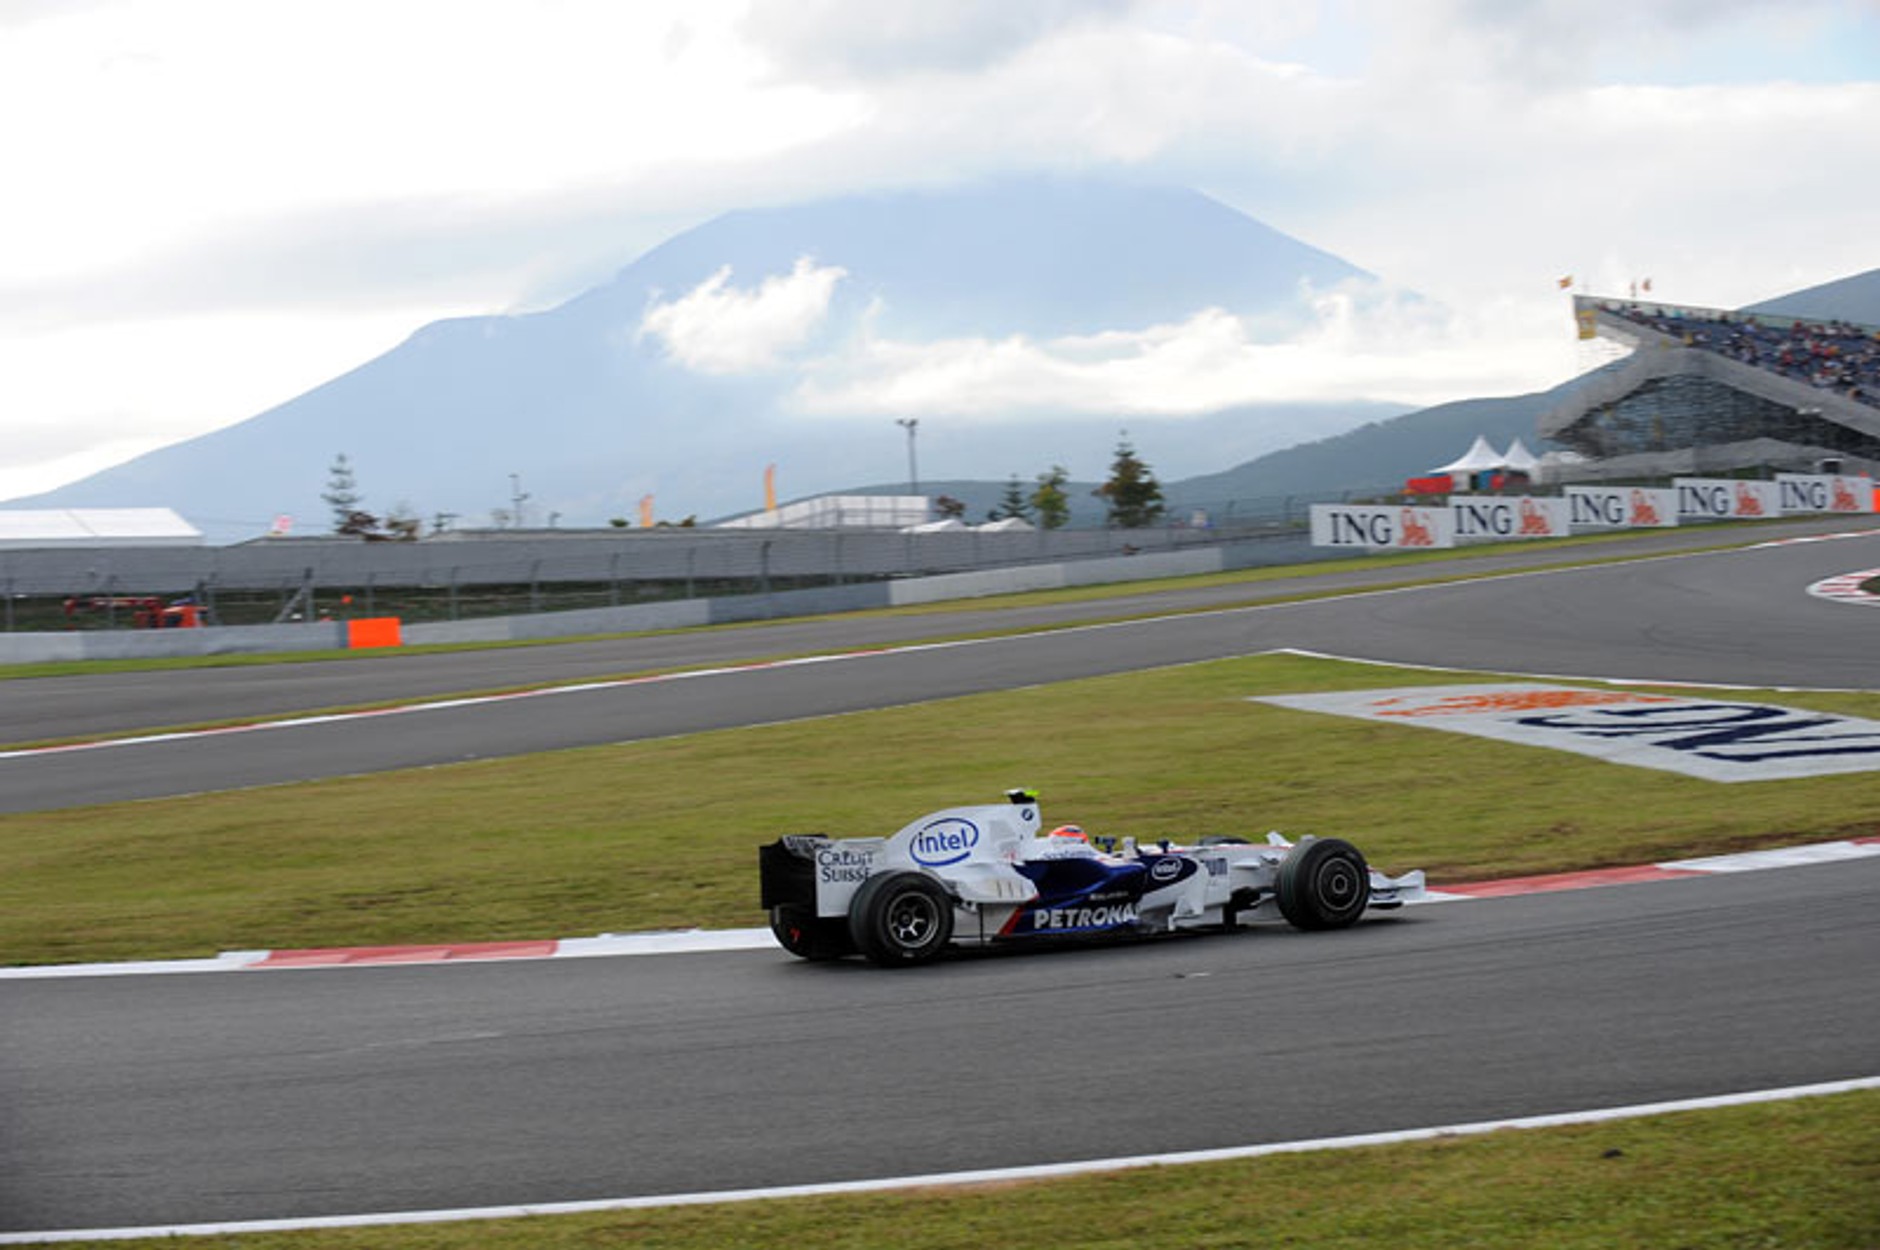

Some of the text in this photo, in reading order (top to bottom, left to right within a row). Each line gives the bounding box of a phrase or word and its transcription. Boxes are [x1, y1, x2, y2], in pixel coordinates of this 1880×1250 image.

[1570, 493, 1624, 524] ING
[1677, 485, 1729, 515] ING
[1779, 480, 1827, 510] ING
[1330, 512, 1392, 545] ING
[1453, 504, 1512, 535] ING
[918, 828, 968, 853] intel
[821, 866, 871, 882] SUISSE
[1034, 902, 1142, 929] PETRONA
